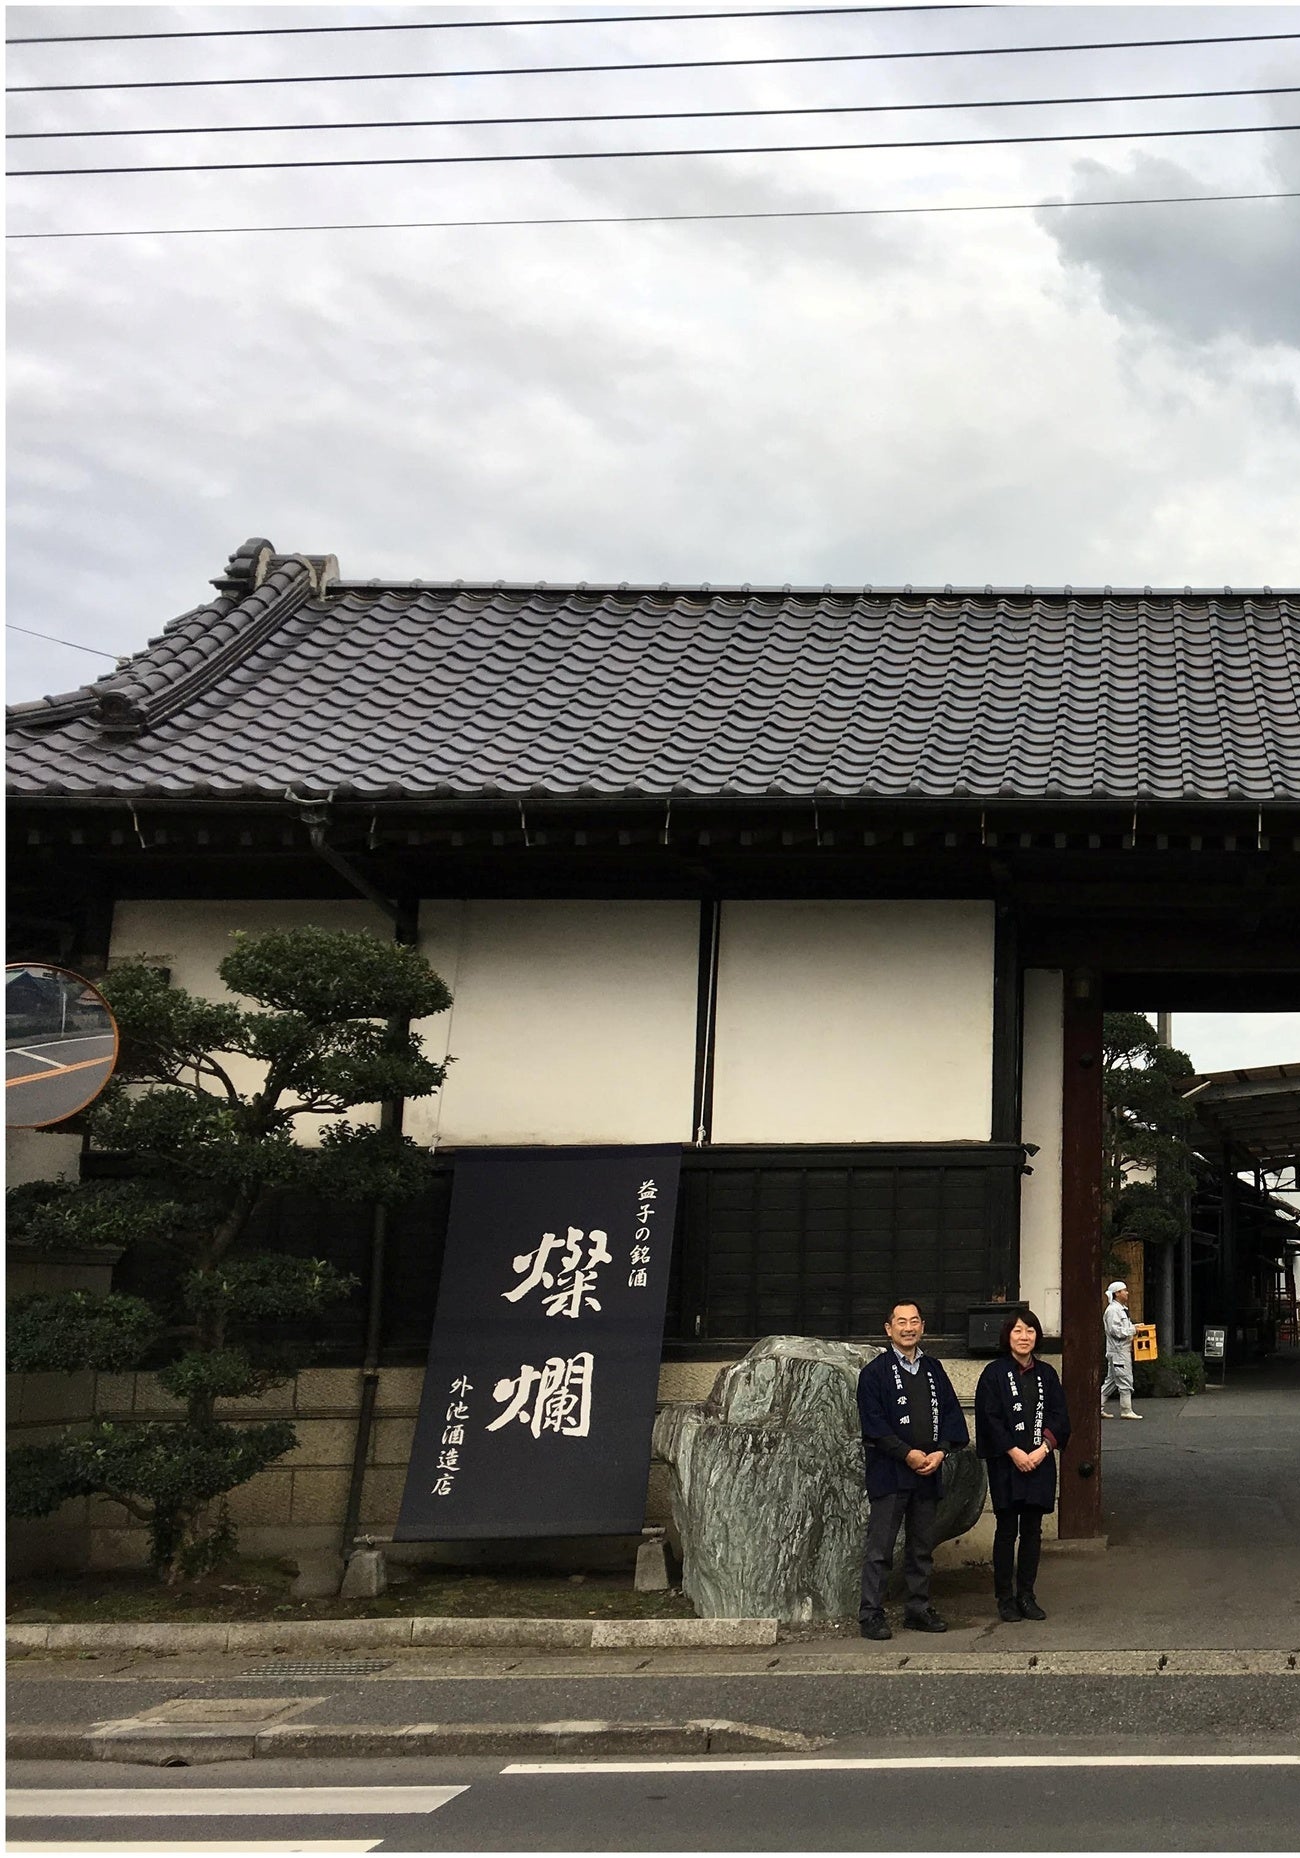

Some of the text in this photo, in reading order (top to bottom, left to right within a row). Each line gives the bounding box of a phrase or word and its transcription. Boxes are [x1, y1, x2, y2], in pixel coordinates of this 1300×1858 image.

[627, 1178, 659, 1288] 益子の銘酒
[484, 1226, 613, 1439] 燦爛
[430, 1375, 474, 1496] 外池酒造店
